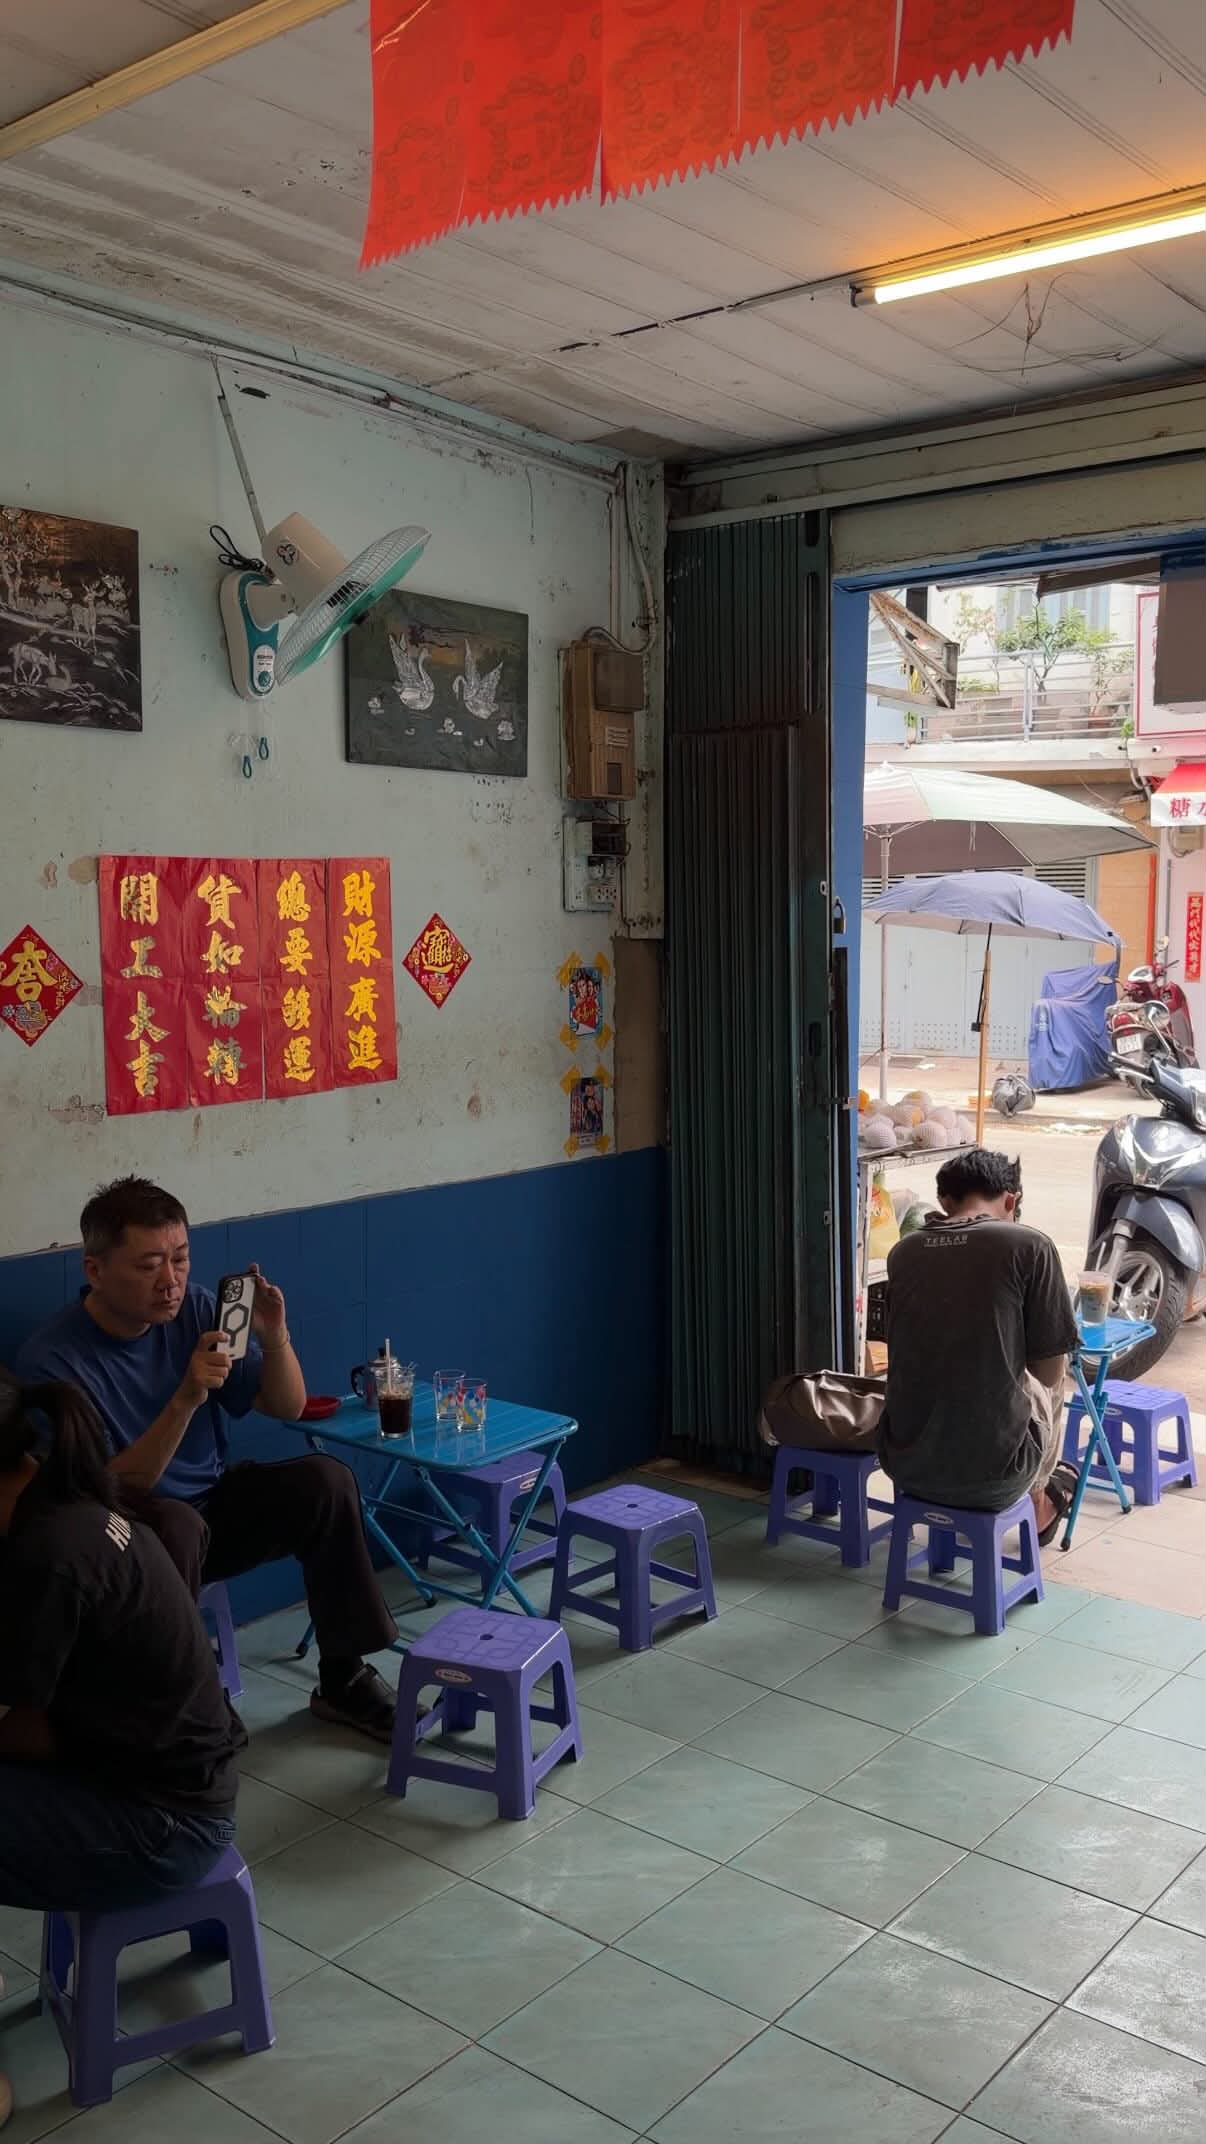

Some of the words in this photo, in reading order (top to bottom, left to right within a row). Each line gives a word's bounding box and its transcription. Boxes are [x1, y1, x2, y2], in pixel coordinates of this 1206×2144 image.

[119, 872, 171, 1097] 開工大吉
[197, 873, 248, 1086] 貨如輪轉
[342, 869, 383, 1070] 財源廣進
